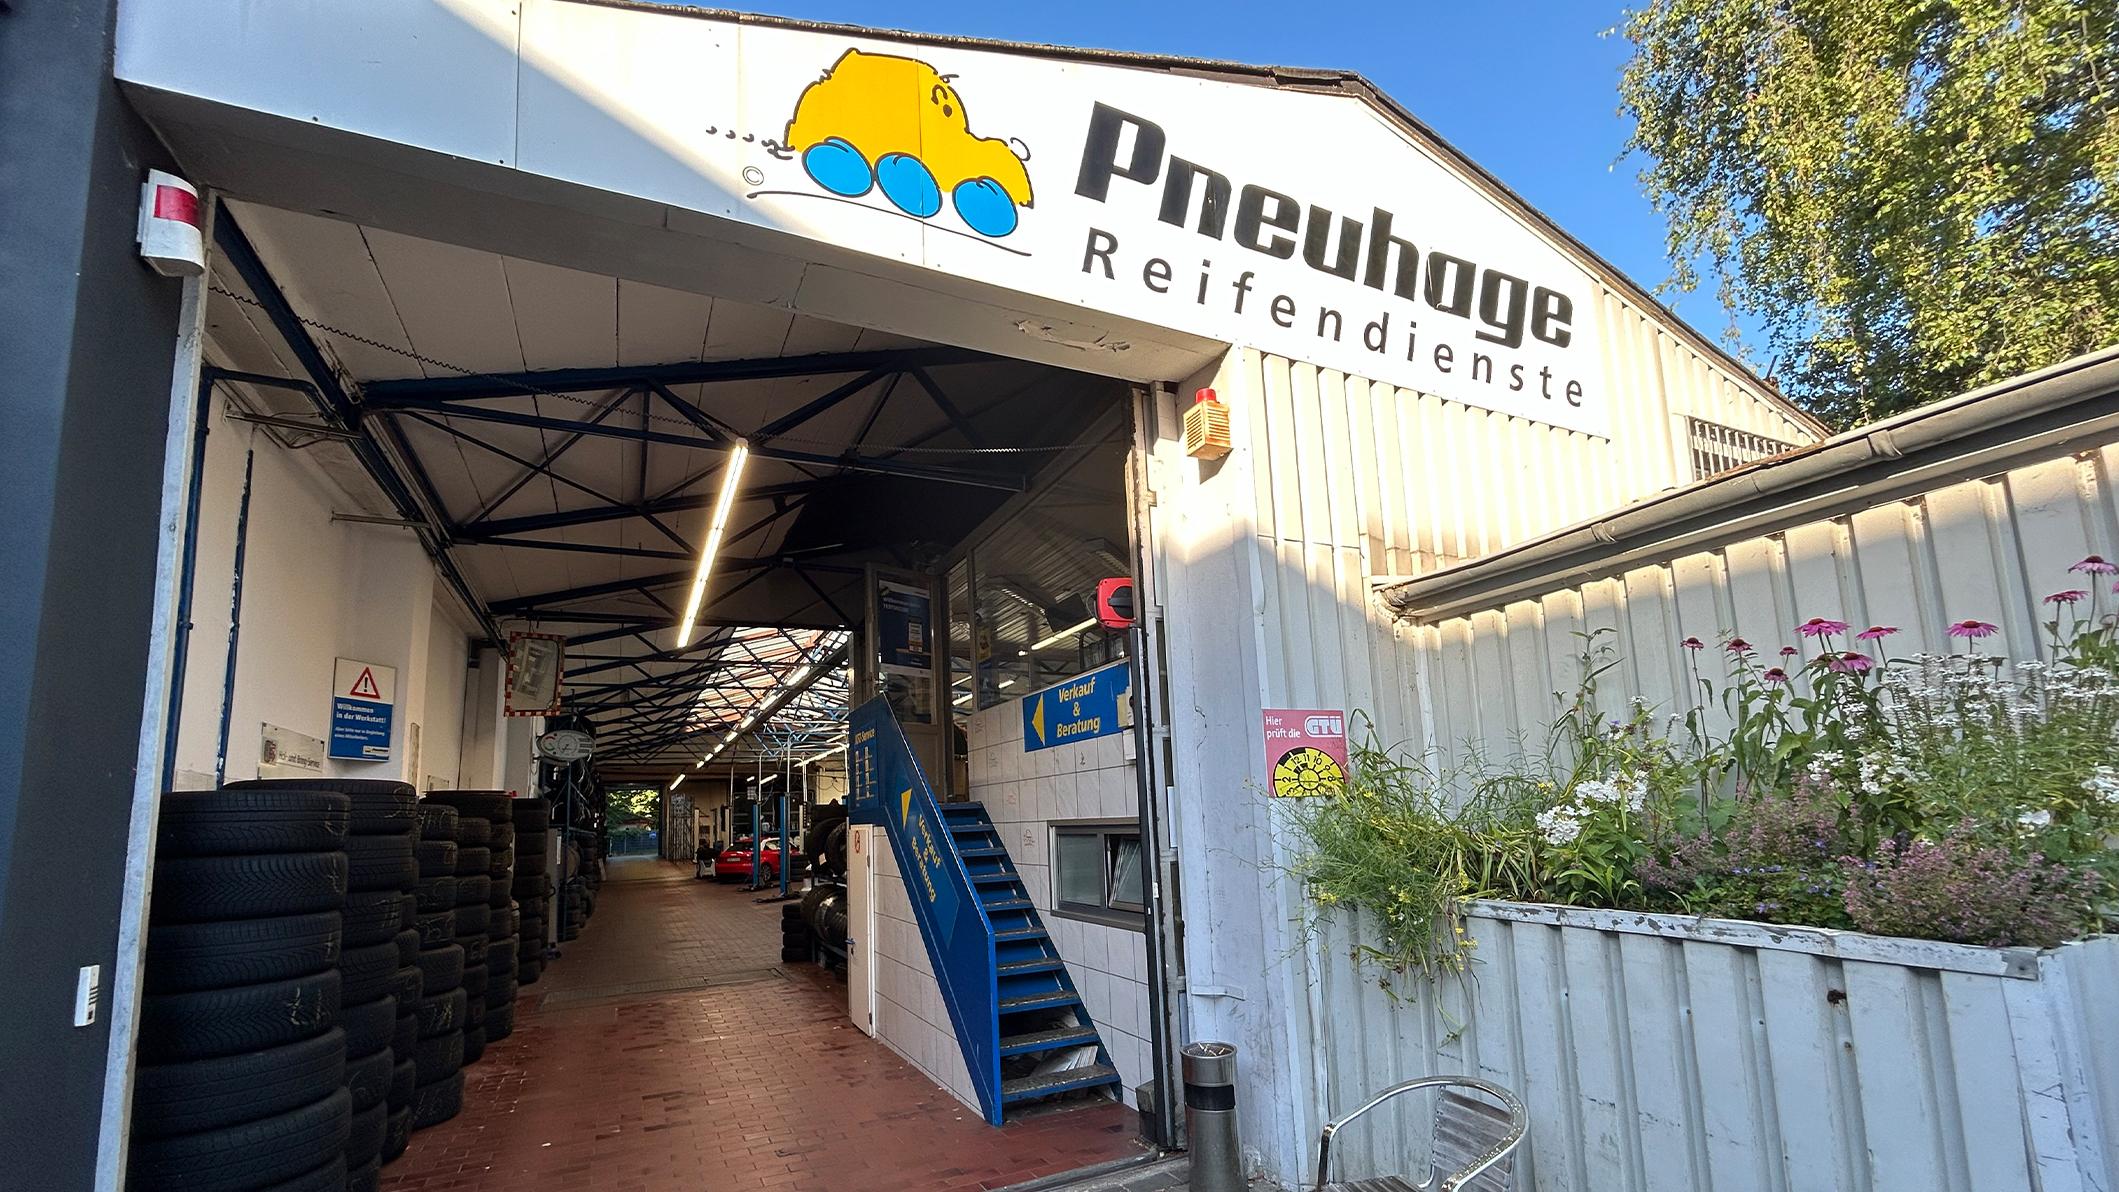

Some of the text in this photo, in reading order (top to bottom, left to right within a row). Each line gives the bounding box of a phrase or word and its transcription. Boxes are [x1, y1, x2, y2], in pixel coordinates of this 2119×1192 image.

[1074, 101, 1573, 349] Pneuhage
[1081, 227, 1583, 407] Reifendienste
[1059, 677, 1096, 703] Verkauf
[1073, 701, 1081, 717] &
[1265, 716, 1282, 726] Hier
[1056, 717, 1101, 738] Beratung
[1266, 728, 1301, 740] prüft die
[919, 814, 941, 868] Verkauf
[911, 836, 936, 902] Beratung
